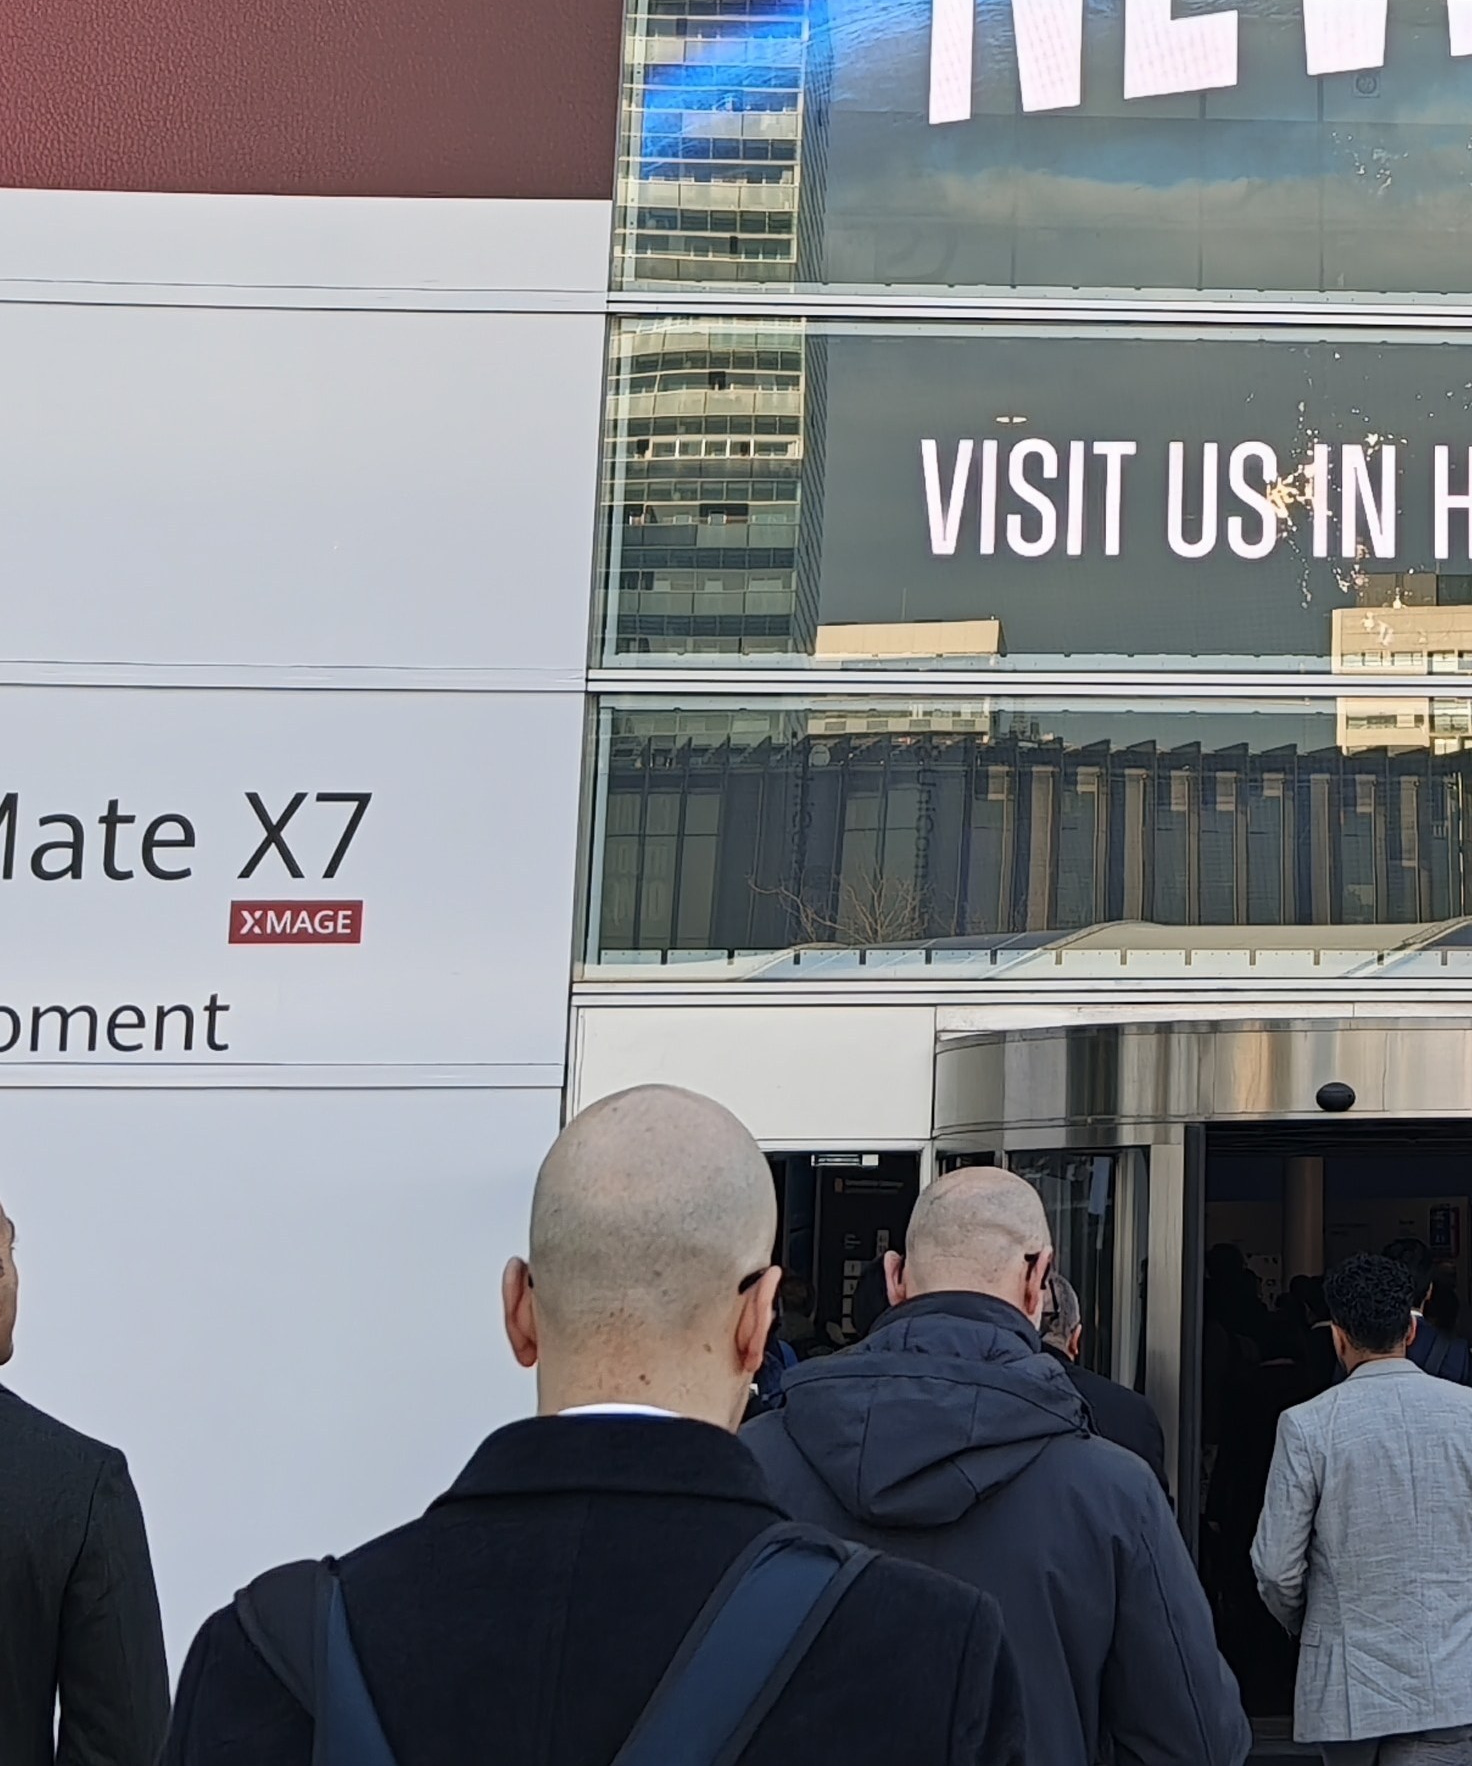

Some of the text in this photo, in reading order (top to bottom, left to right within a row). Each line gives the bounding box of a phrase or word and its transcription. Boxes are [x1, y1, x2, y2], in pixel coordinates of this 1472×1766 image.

[920, 438, 1138, 557] VISIT
[1168, 440, 1278, 559] US
[1313, 442, 1396, 560] IN
[237, 791, 374, 879] X7
[239, 910, 354, 935] XMAGE
